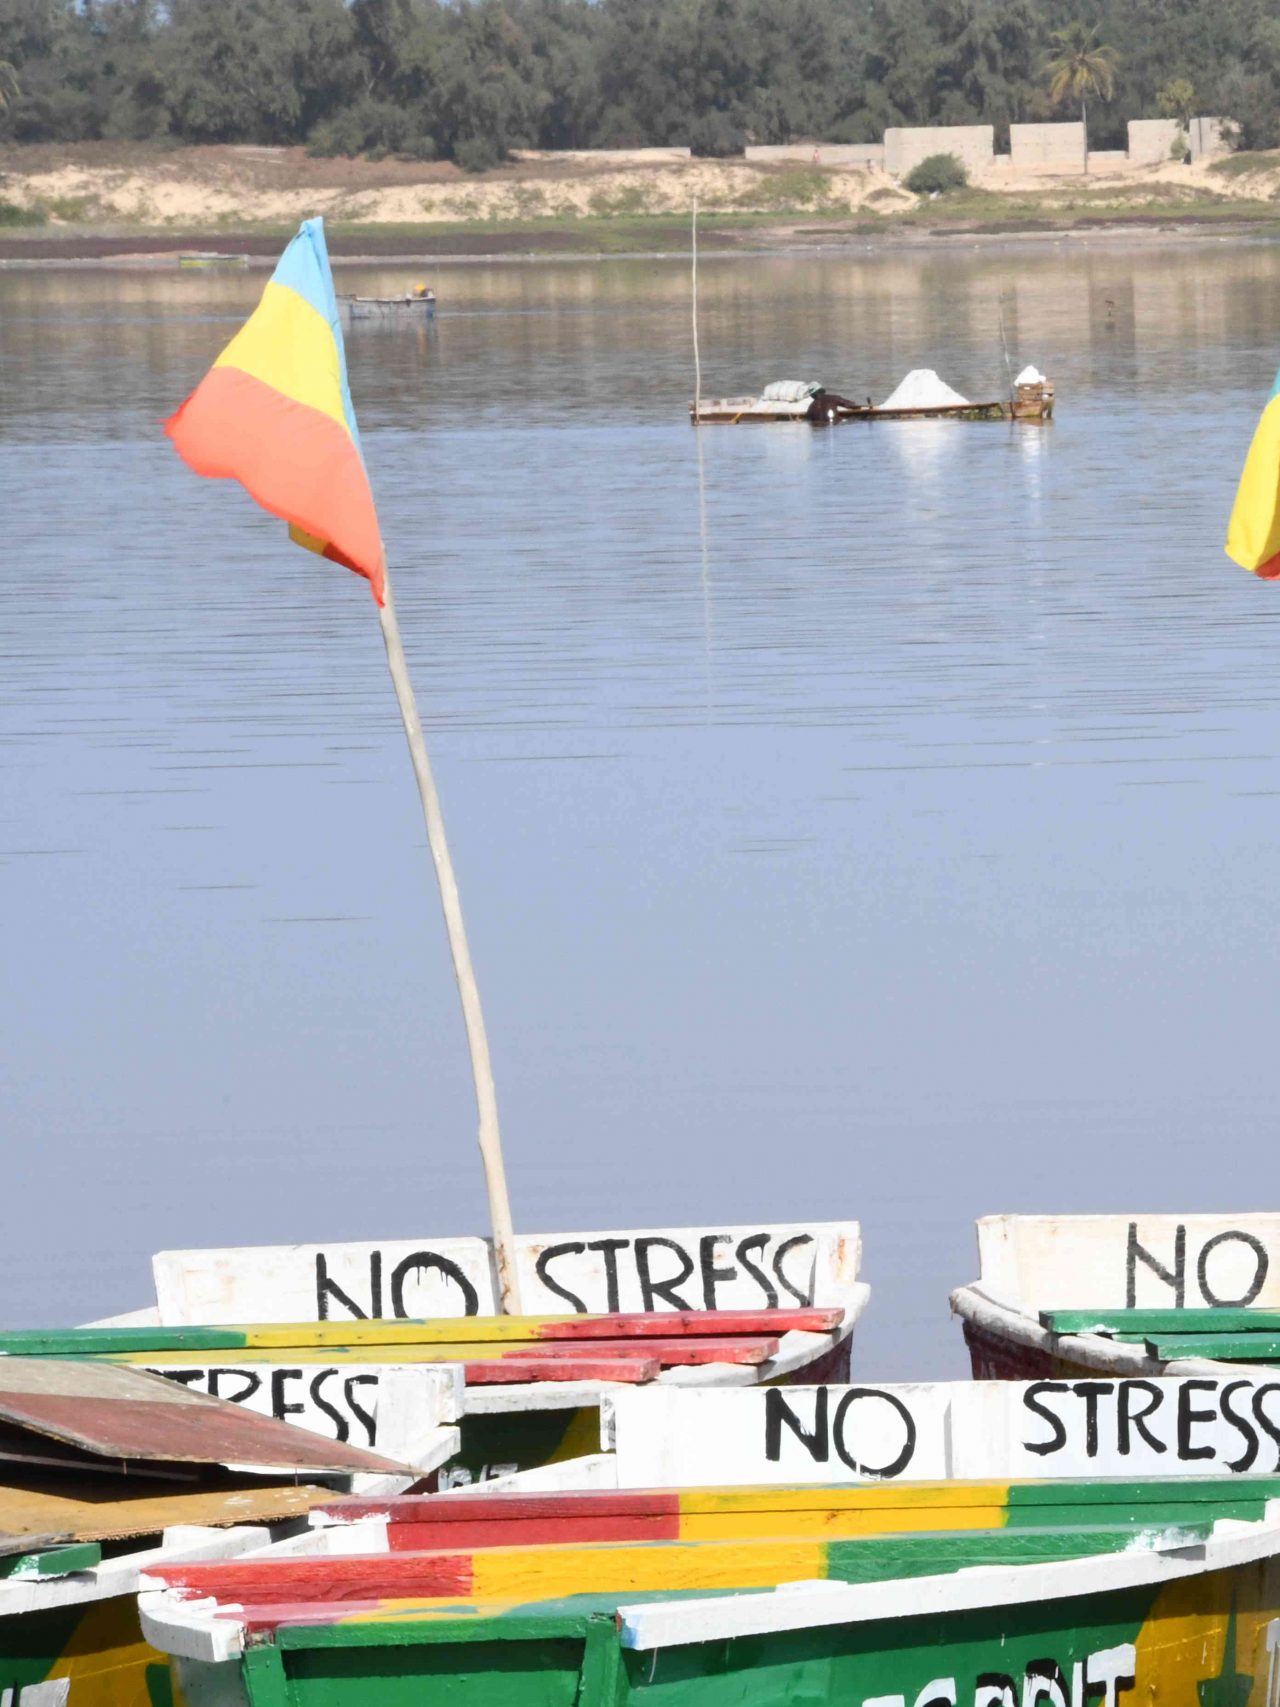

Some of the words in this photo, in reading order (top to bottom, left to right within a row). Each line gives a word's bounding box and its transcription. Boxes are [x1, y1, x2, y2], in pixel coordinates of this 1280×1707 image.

[316, 1250, 479, 1319] NO
[535, 1232, 815, 1313] STRESS
[1125, 1222, 1269, 1308] NO
[764, 1387, 917, 1479] NO
